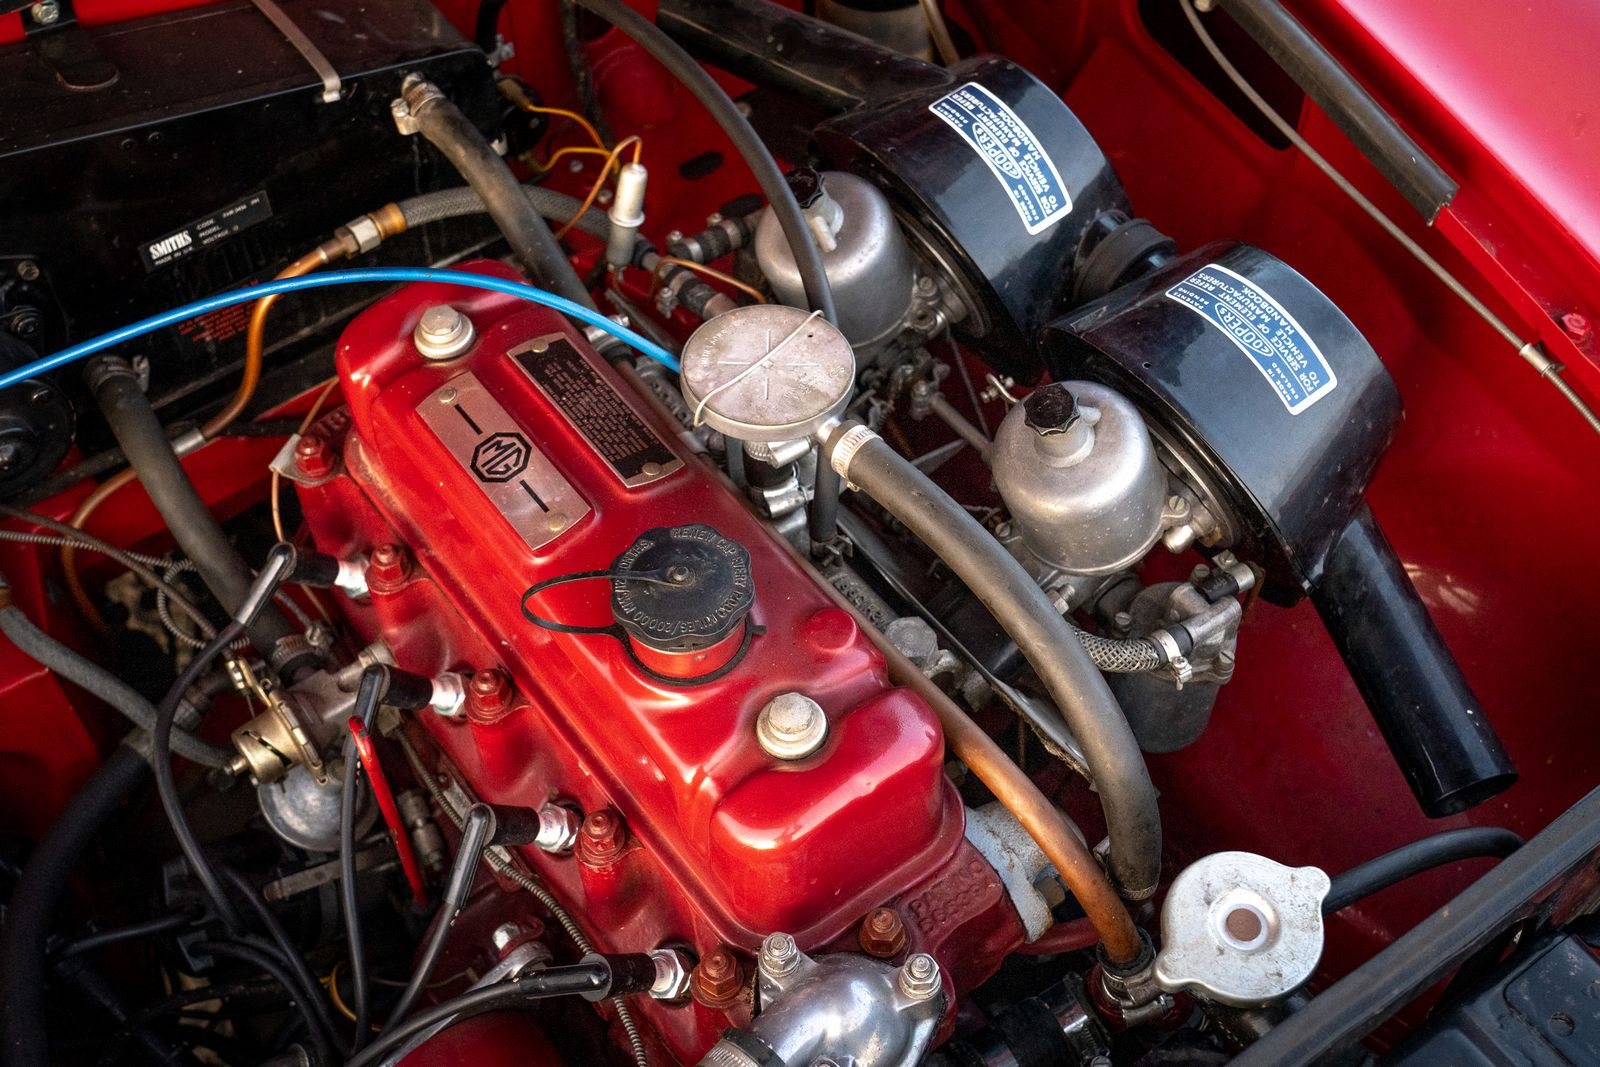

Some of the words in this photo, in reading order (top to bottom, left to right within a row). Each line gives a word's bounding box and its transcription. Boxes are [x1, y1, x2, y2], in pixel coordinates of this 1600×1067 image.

[941, 102, 969, 124] PENDING
[951, 94, 976, 111] REFER
[960, 90, 1021, 147] MANUFACTURERS
[976, 113, 1009, 144] ELEMENT
[1008, 146, 1020, 157] OF
[1018, 160, 1043, 195] SERVICE
[1023, 153, 1050, 193] VEHICLE
[1013, 190, 1021, 198] IN
[1017, 184, 1039, 220] ENGLAND
[1049, 195, 1059, 210] TO
[1020, 201, 1033, 222] MADE
[1041, 196, 1053, 215] FOR
[149, 230, 192, 260] SMITHS
[1189, 277, 1215, 291] REFER
[1173, 292, 1204, 310] PATENTS
[1177, 287, 1209, 305] PENDING
[1198, 273, 1271, 322] MANUFACTURERS
[1219, 292, 1256, 321] ELEMENT
[1242, 285, 1295, 335] HANDBOOK.
[1257, 323, 1270, 334] OF
[1270, 337, 1300, 372] SERVICE
[1275, 329, 1308, 369] VEHICLE
[1267, 368, 1275, 377] IN
[1272, 362, 1299, 400] ENGLAND
[1300, 373, 1314, 392] FOR
[1309, 371, 1320, 387] TO
[1276, 380, 1292, 401] MADE
[478, 438, 524, 476] MG
[715, 539, 737, 556] CAP
[732, 556, 748, 588] EVERY
